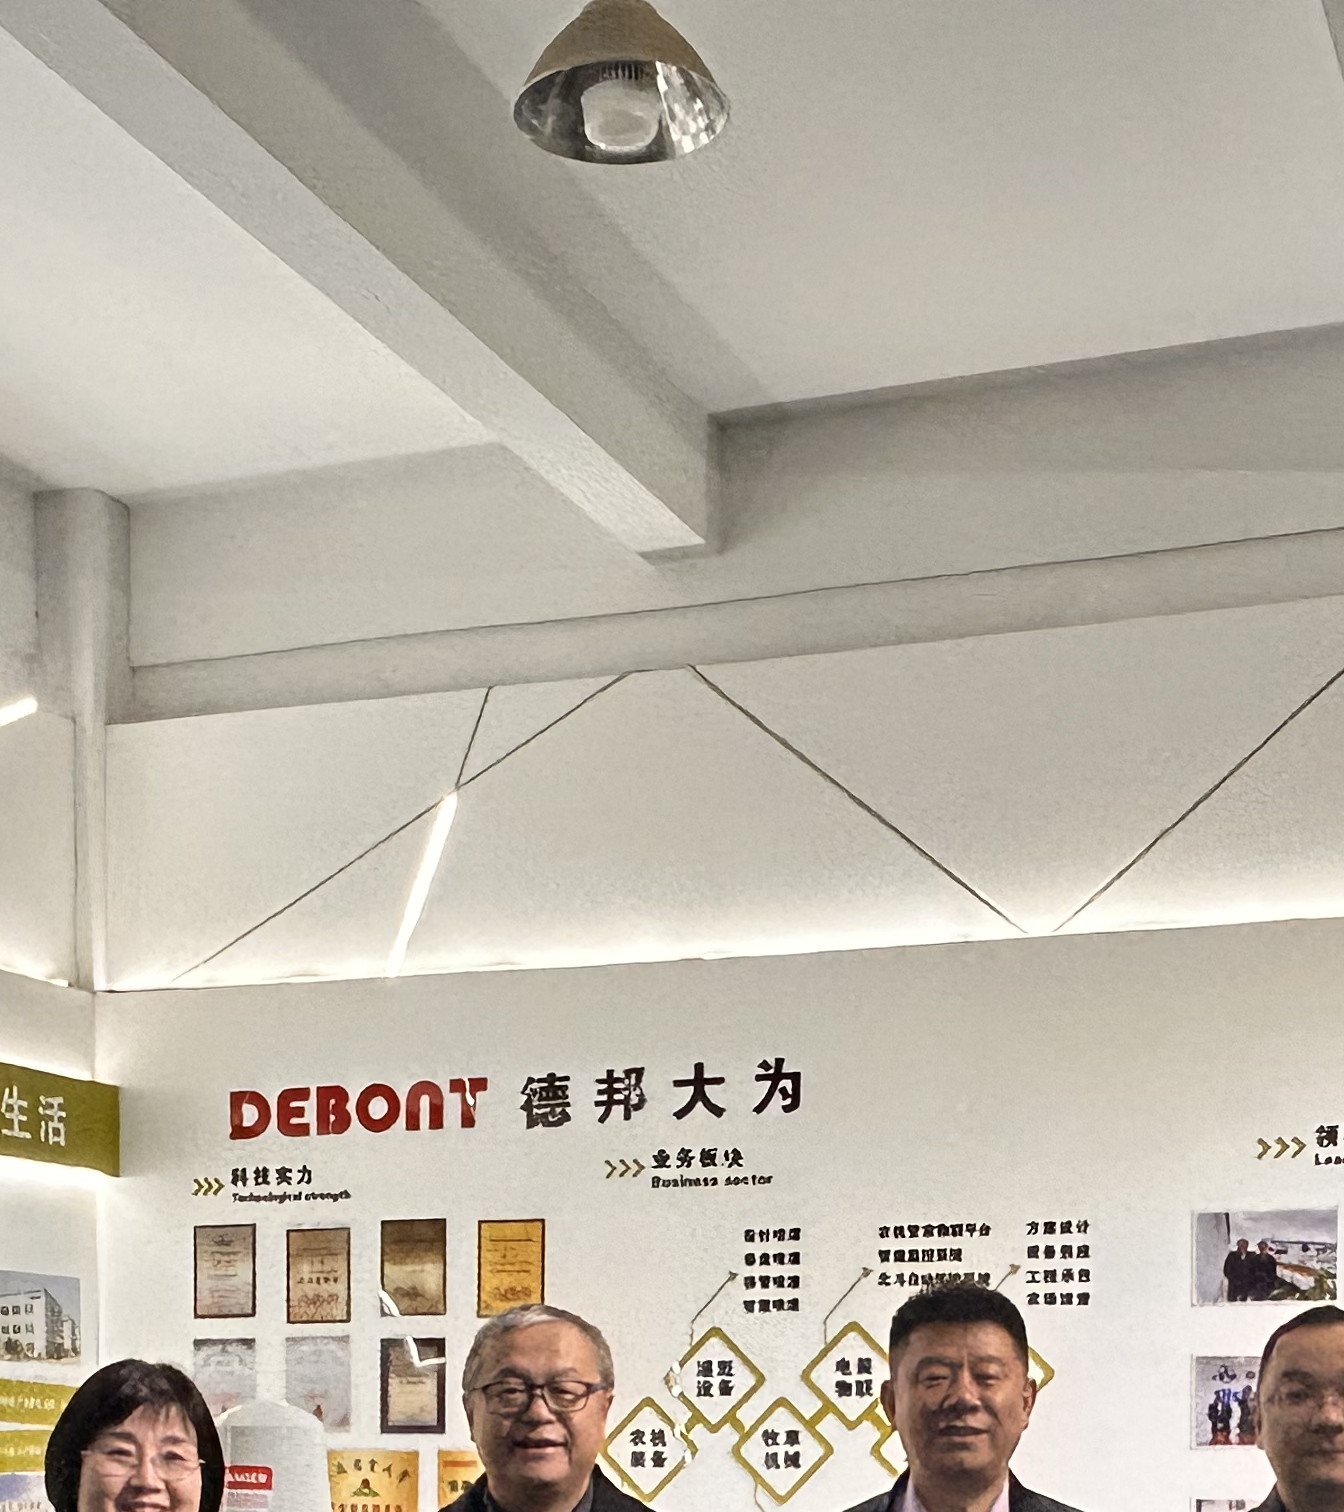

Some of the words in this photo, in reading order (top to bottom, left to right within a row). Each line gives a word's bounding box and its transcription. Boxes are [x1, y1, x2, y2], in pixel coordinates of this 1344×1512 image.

[519, 1057, 803, 1130] 德邦大为
[229, 1077, 488, 1140] DEBONT
[651, 1147, 744, 1169] 业务板块
[231, 1165, 312, 1187] 科技实力
[651, 1174, 719, 1189] Business
